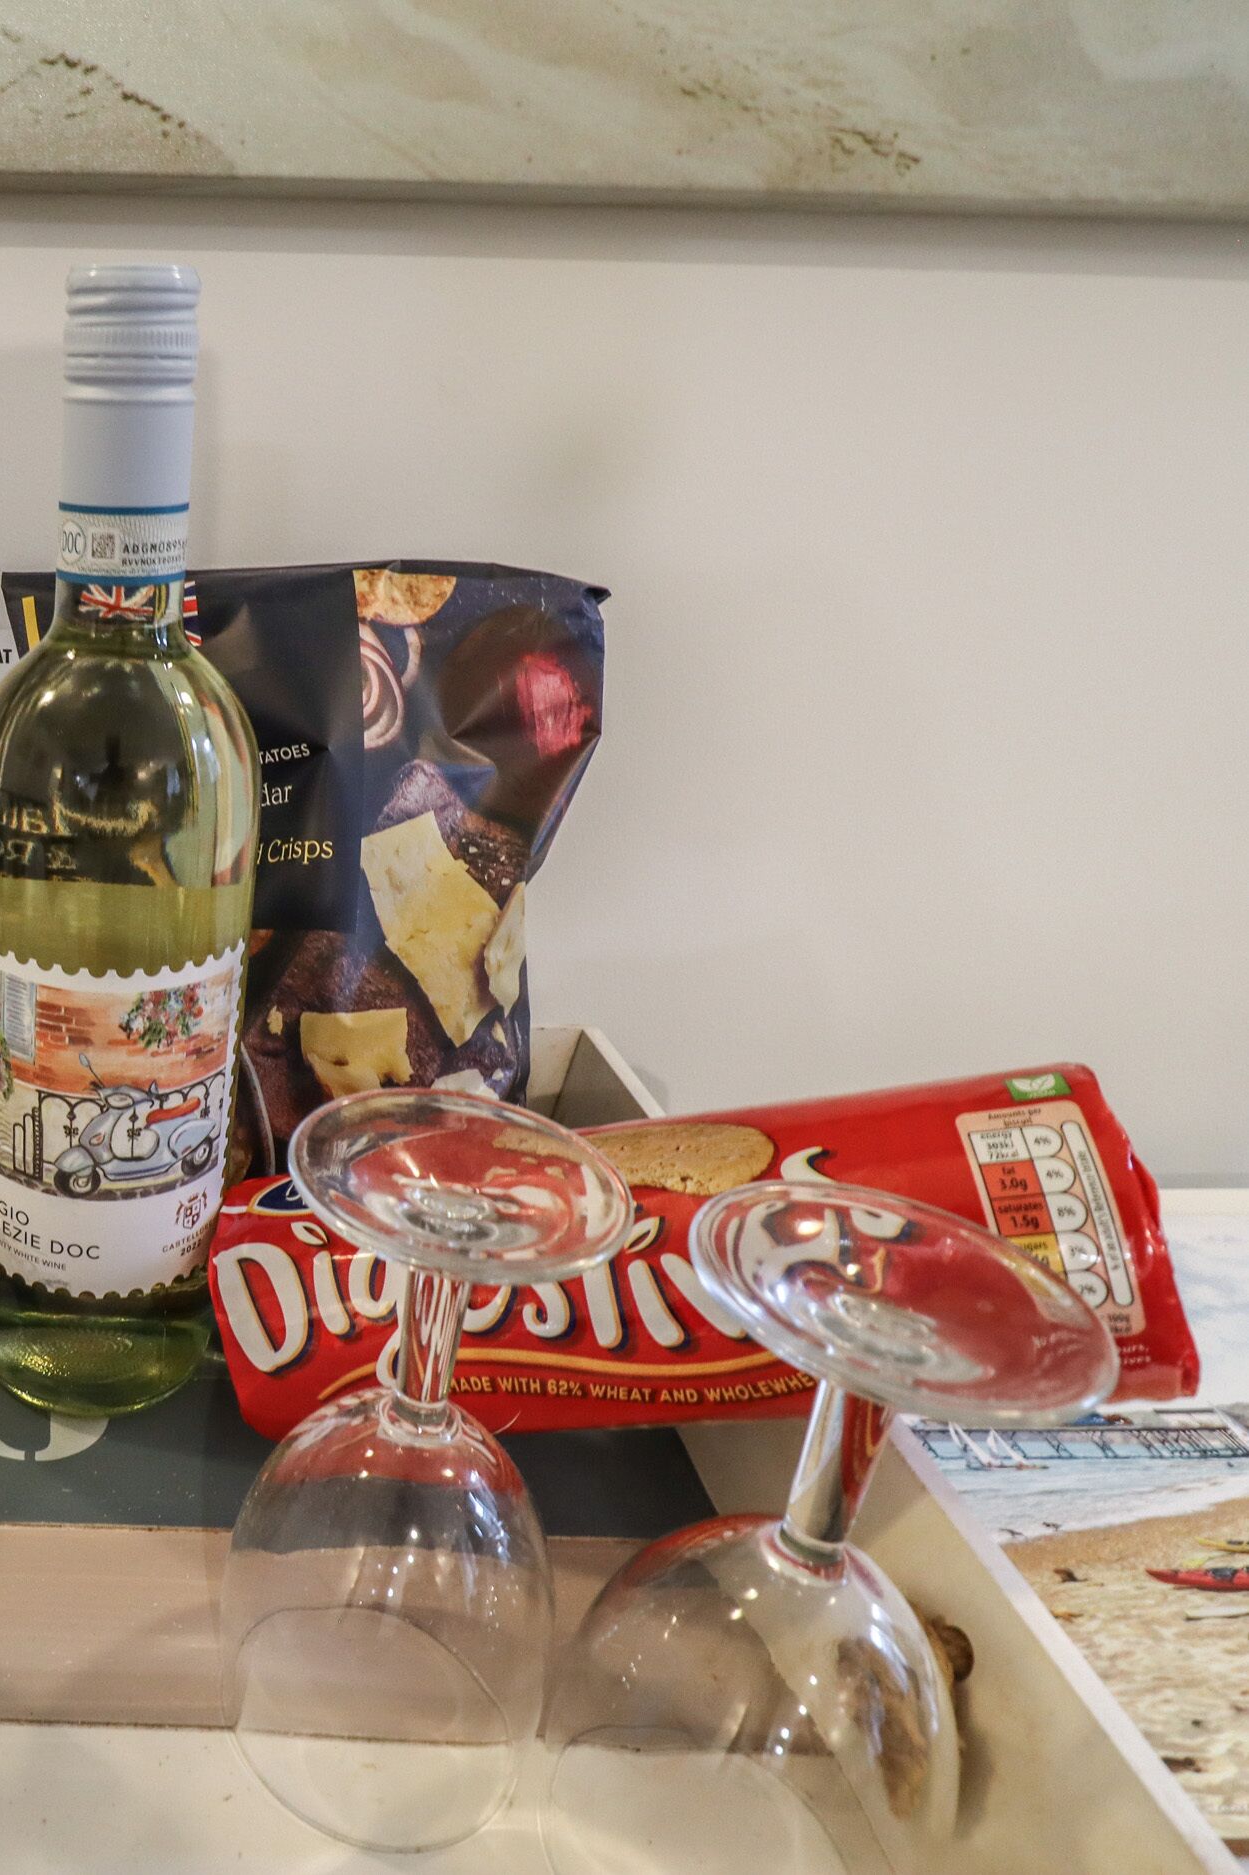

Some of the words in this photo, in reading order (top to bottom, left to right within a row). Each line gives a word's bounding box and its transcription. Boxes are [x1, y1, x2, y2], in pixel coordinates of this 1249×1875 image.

[267, 837, 333, 865] Crisps
[1010, 1215, 1040, 1229] 1.5g
[13, 1247, 39, 1264] WHITE
[42, 1258, 67, 1271] WINE
[51, 1240, 100, 1260] DOC
[498, 1377, 541, 1394] WITH
[547, 1378, 582, 1396] 62%
[590, 1384, 651, 1403] WHEAT
[660, 1387, 699, 1403] AND
